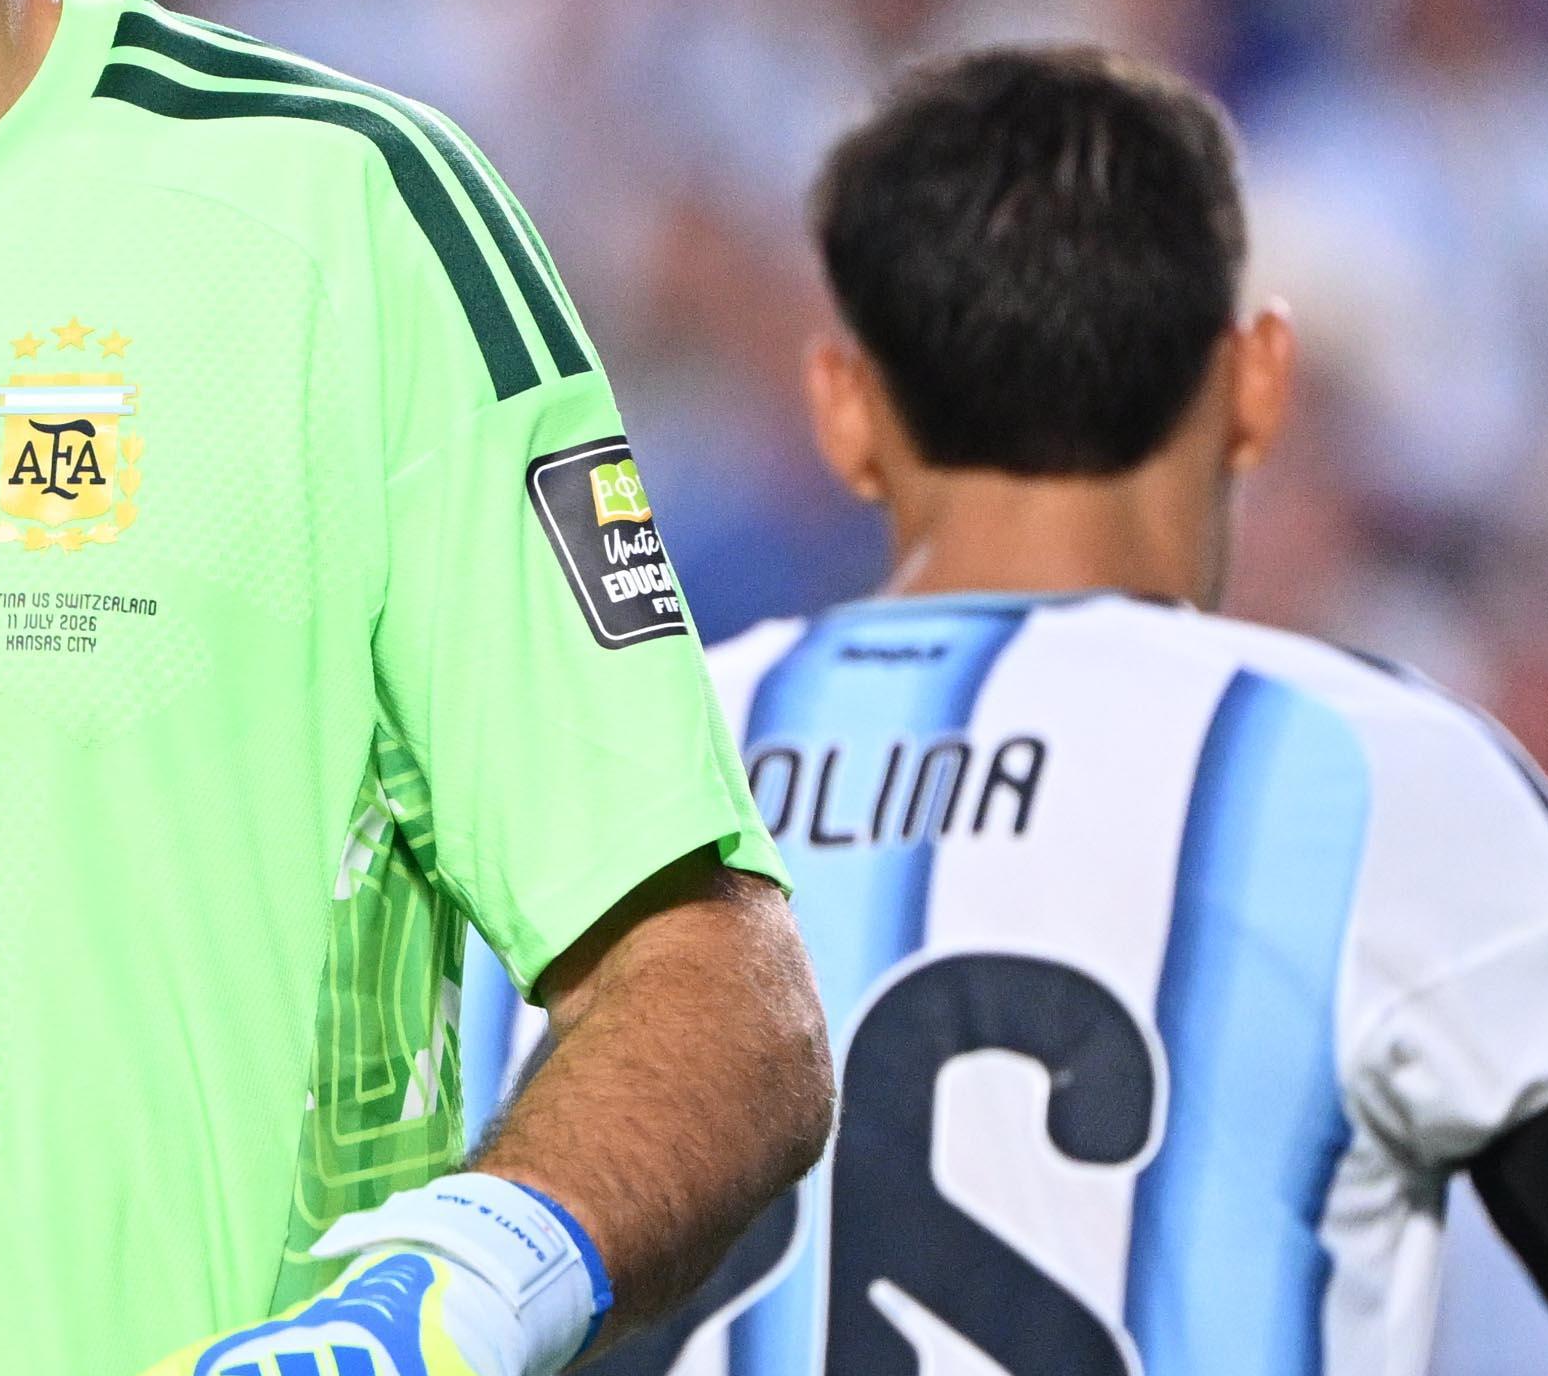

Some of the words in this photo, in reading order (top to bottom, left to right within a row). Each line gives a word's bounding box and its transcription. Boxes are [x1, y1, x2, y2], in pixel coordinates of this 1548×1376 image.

[8, 418, 106, 500] AFA
[603, 526, 660, 566] Unite
[600, 562, 676, 603] EDUCA
[55, 593, 157, 616] SWITZERLAND
[651, 596, 681, 614] FIF
[7, 614, 18, 629] 11
[23, 613, 54, 630] JULY
[59, 614, 97, 632] 2026
[6, 634, 62, 652] KANSAS
[67, 636, 97, 653] CITY
[750, 736, 1047, 847] OLINA
